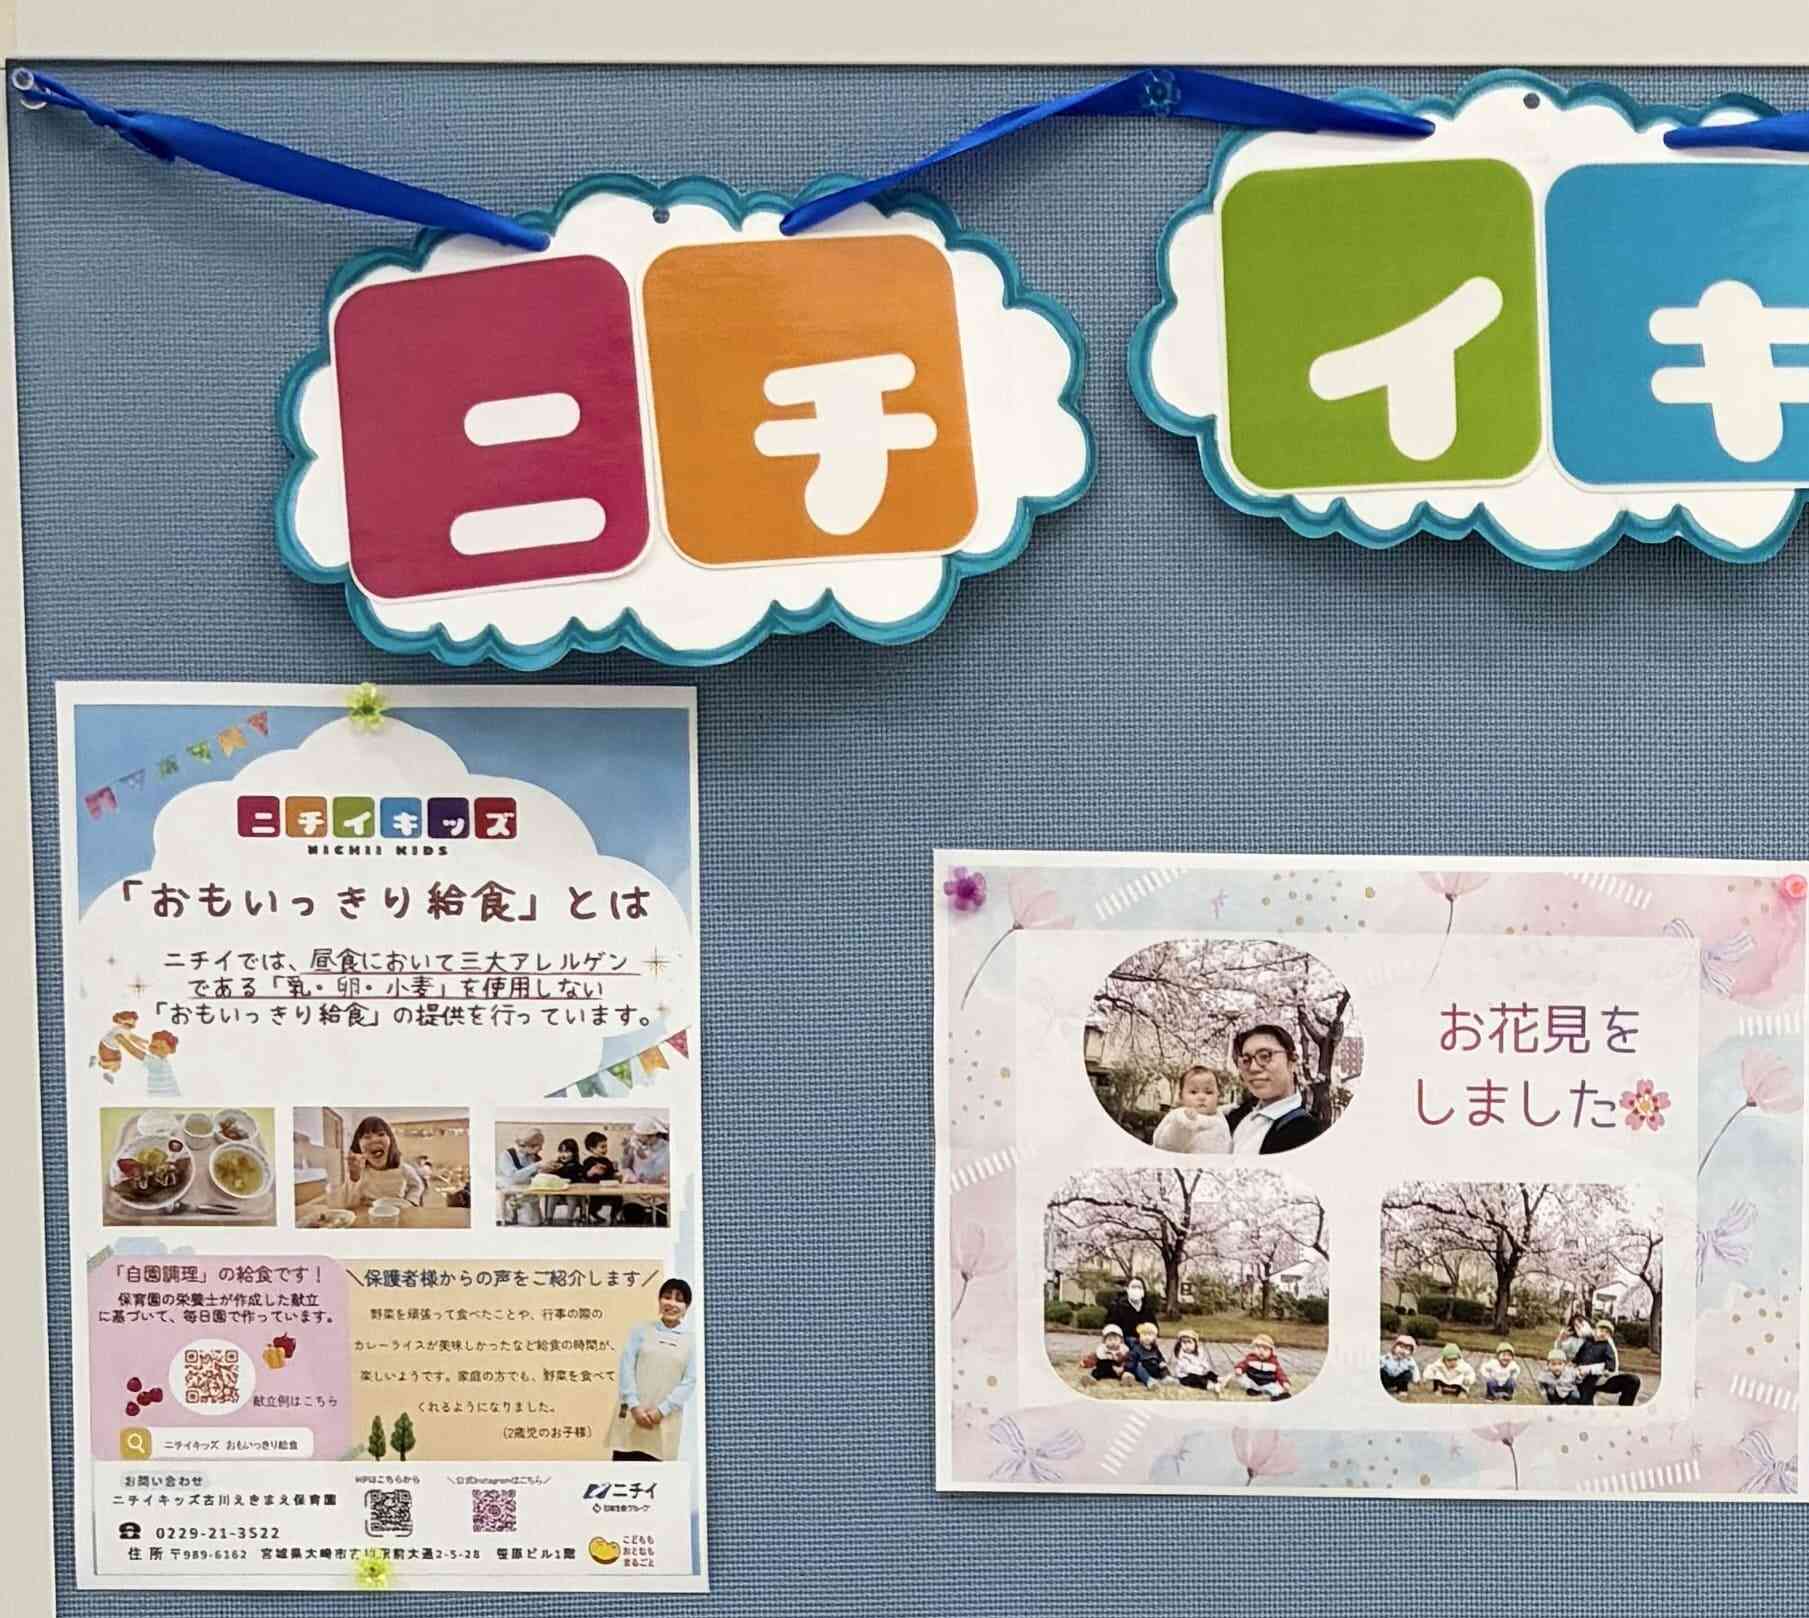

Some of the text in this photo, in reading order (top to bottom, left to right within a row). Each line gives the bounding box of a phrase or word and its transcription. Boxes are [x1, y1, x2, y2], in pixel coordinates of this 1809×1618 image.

[245, 803, 517, 838] ニチイキッズ
[307, 845, 448, 856] NICHII KIDS
[122, 879, 651, 923] 「おもいっきり給食」とは
[163, 947, 636, 977] ニチイでは、昼食において三大アレルゲン
[187, 975, 603, 1001] である「乳・卵・小麦」を使用しない
[155, 1001, 650, 1028] 「おもいっきり給食」の提供を行っています。
[1440, 1001, 1640, 1054] お花見を
[1417, 1079, 1619, 1129] しました
[417, 1400, 556, 1414] くれるようになりました。
[155, 1526, 280, 1540] 0229-21-3522
